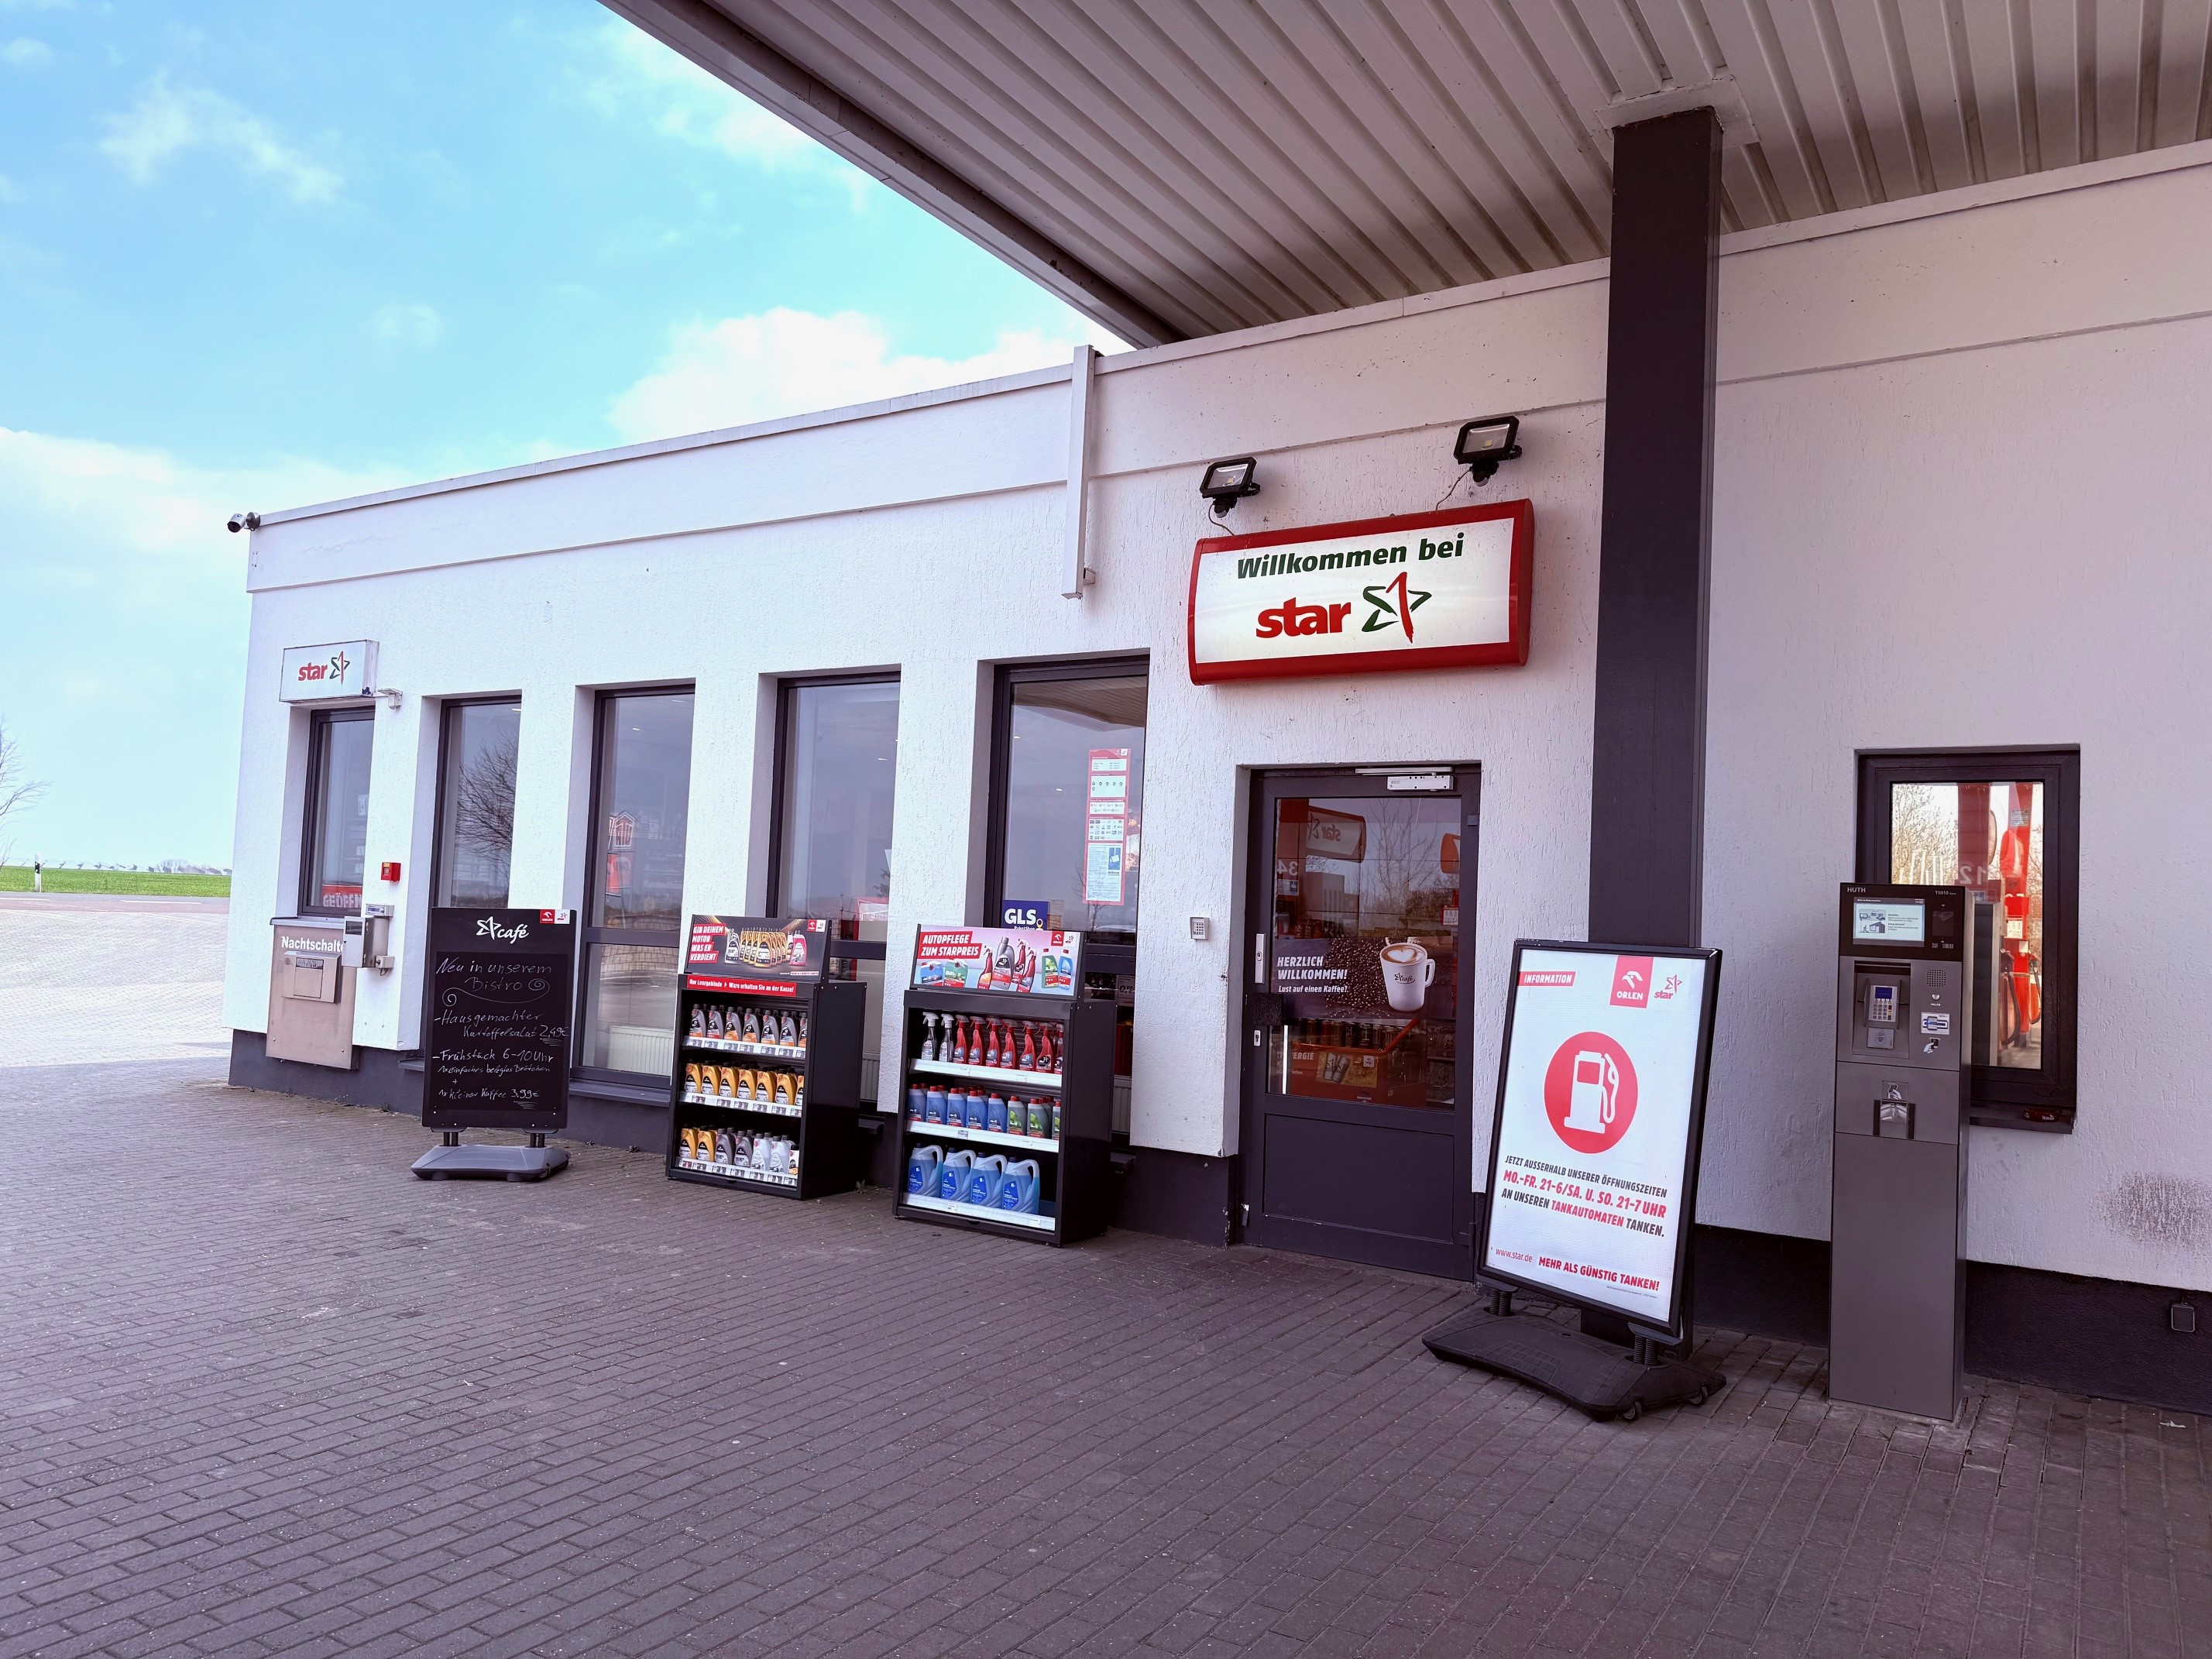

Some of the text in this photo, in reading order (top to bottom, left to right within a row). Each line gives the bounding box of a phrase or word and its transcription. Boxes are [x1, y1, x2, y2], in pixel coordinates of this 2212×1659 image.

[1238, 532, 1465, 579] Willkommen bei
[1255, 596, 1352, 638] star
[298, 661, 328, 681] star
[322, 892, 362, 908] GEÖFFN
[1004, 908, 1037, 926] GLS
[497, 924, 530, 944] café
[922, 933, 970, 944] AUTOPFLEGE
[281, 936, 343, 953] Nachtschalt
[920, 946, 980, 957] ZUM STARPREIS
[435, 957, 551, 974] Neu in unserem
[1277, 956, 1324, 967] HERZLICH
[1278, 969, 1348, 981] WILLKOMMEN!
[1524, 974, 1573, 984] INFORMATION
[465, 977, 523, 992] Bistro
[1304, 984, 1322, 993] einen
[1323, 984, 1348, 994] Kaffee?
[1616, 991, 1644, 1001] ORLEN
[1654, 990, 1674, 1000] star
[1505, 1155, 1668, 1198] JETZT AUSSERHALB UNSERER ÖFFNUNGSZEITEN
[1503, 1170, 1668, 1218] MO.-FR. 21-6/SA. U. SO. 21-7 UHR
[1501, 1188, 1664, 1237] AN UNSEREN TANKAUTOMATEN TANKEN.
[1496, 1248, 1661, 1291] www.star.de MEHR ALS GÜNSTIG TANKEN!
